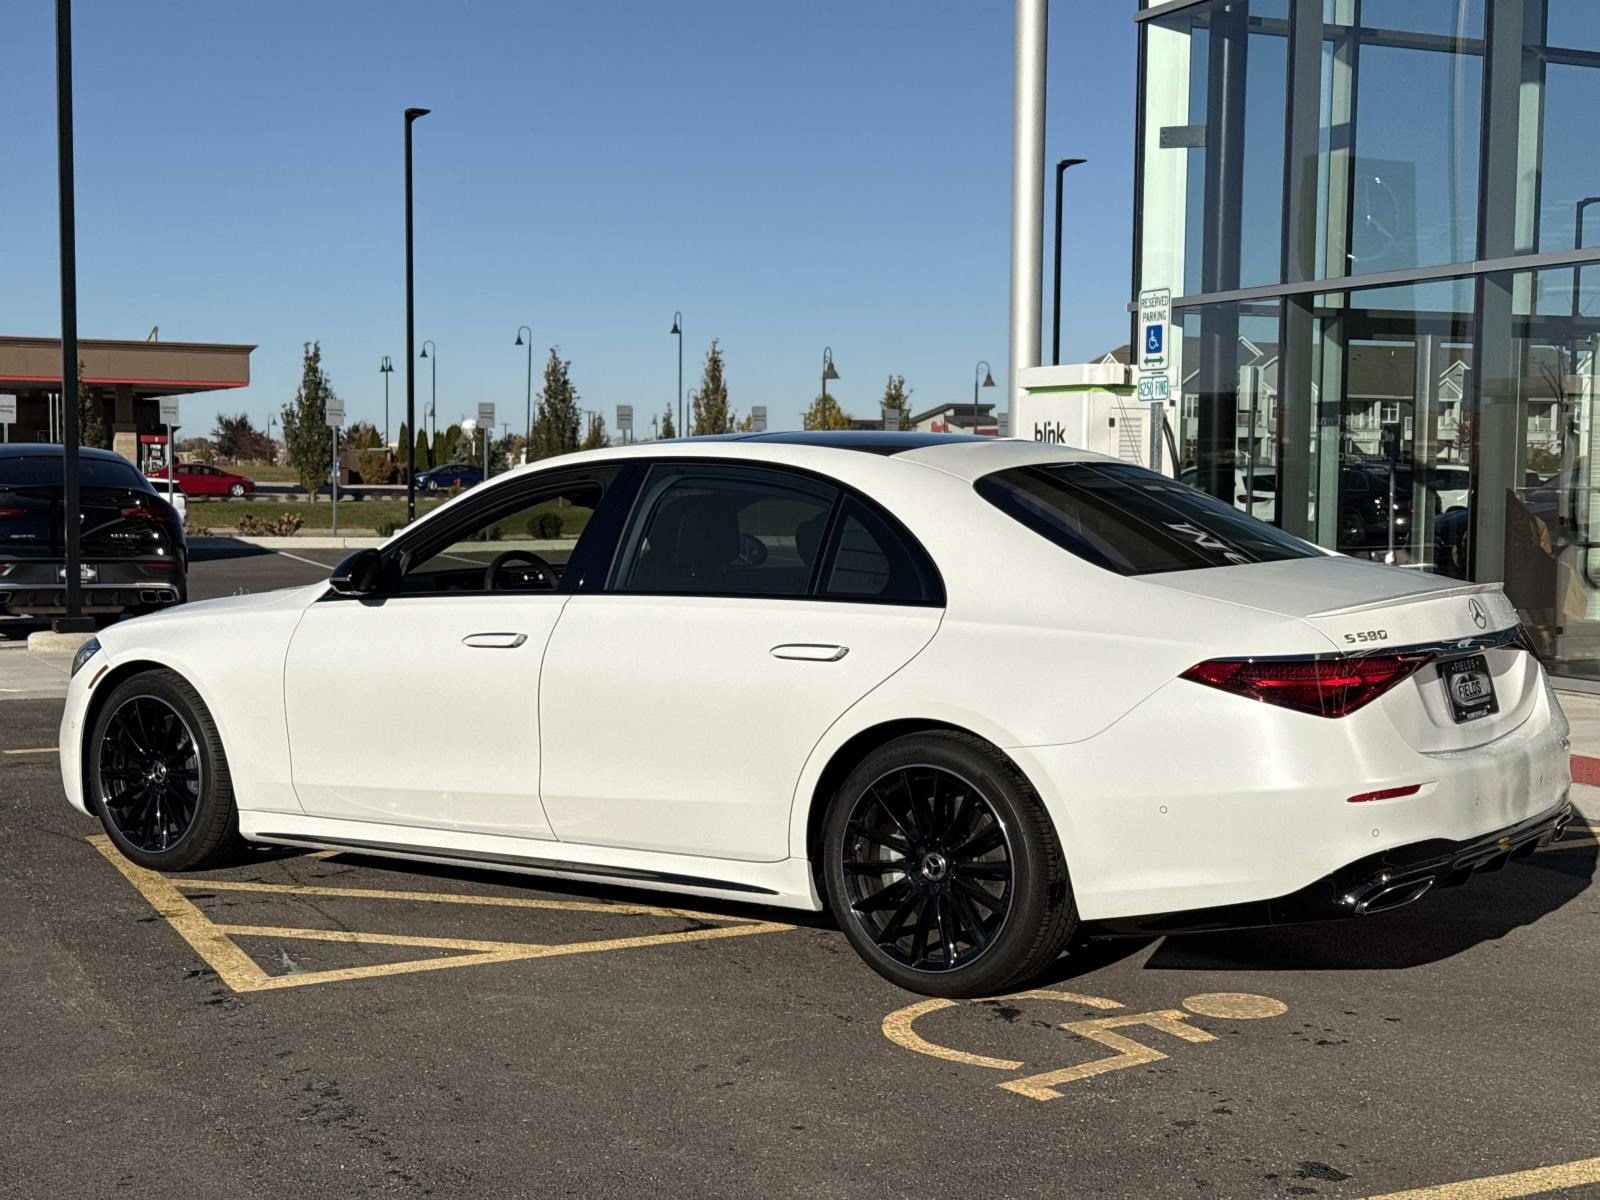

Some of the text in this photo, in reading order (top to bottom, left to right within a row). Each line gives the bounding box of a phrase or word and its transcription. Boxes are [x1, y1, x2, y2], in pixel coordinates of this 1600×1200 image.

[1141, 296, 1169, 309] RESERVED
[1142, 310, 1167, 322] PARKING
[1140, 380, 1167, 397] $250 FINE
[1034, 421, 1066, 444] blink
[1344, 629, 1388, 644] S 580
[1454, 658, 1477, 673] FIELDS
[1458, 680, 1482, 698] FIELDS
